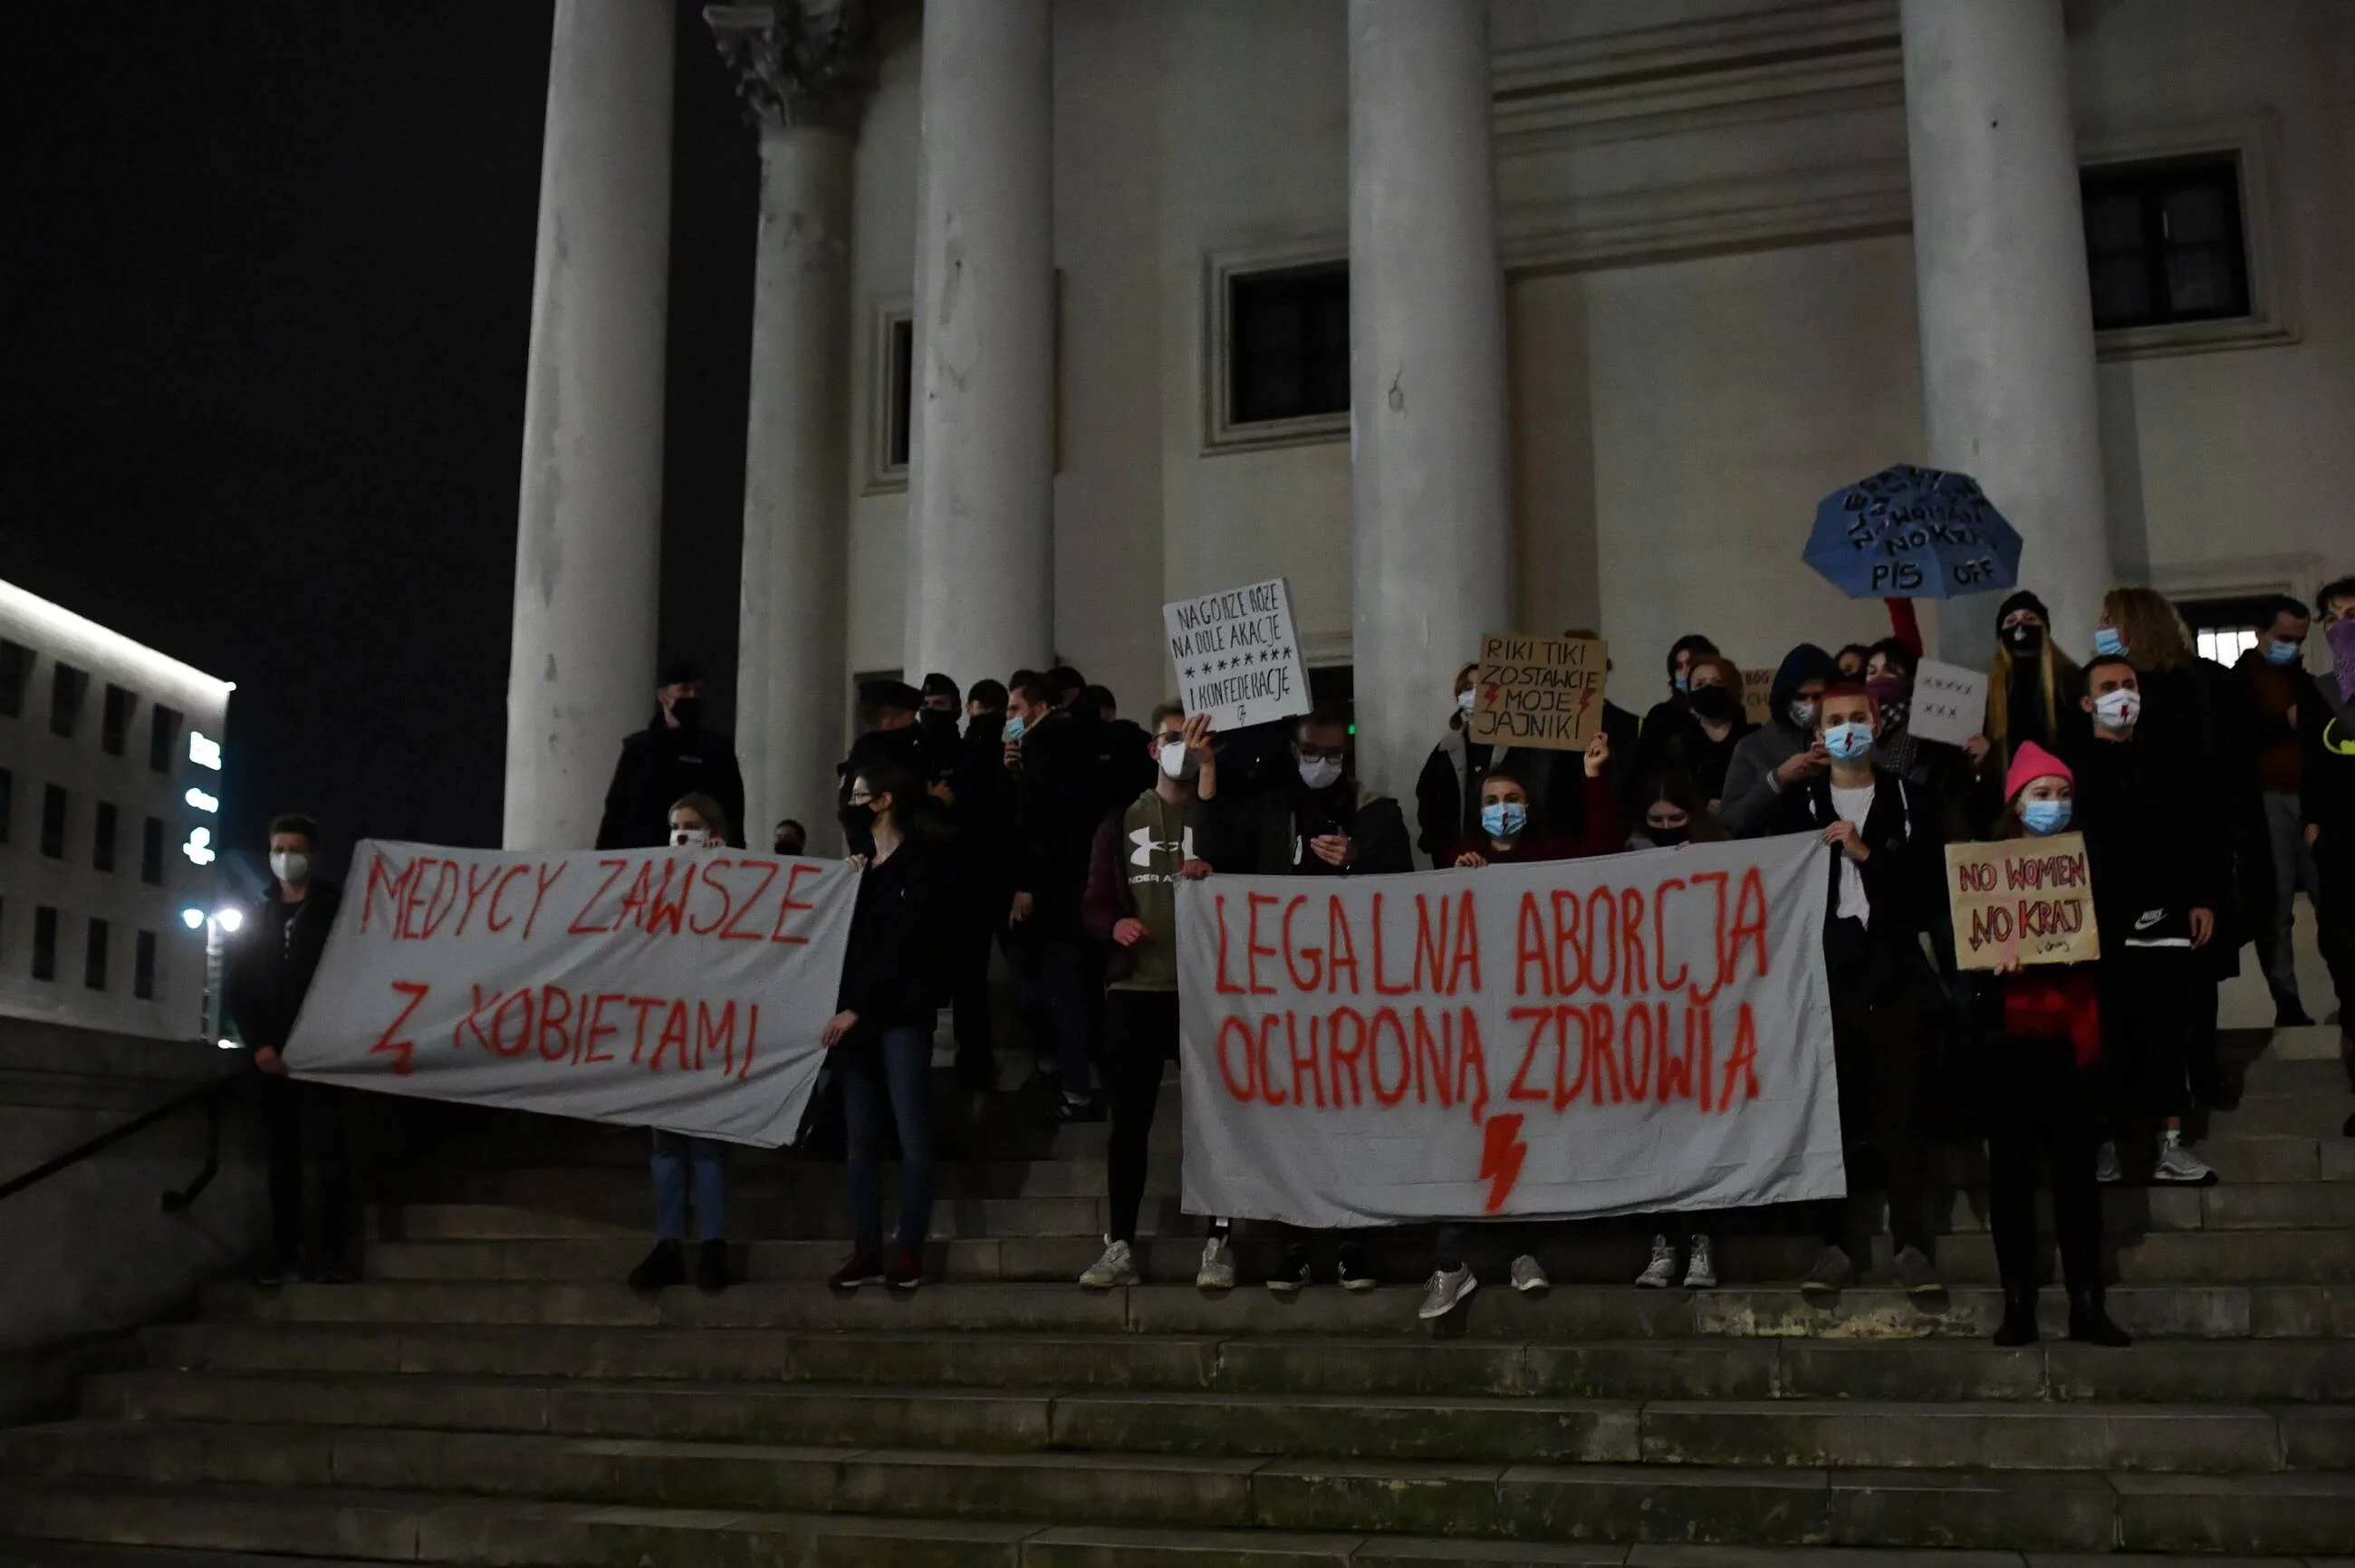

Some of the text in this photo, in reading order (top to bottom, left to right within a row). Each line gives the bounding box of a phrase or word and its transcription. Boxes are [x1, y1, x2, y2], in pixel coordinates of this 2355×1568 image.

[1872, 561, 1924, 591] PIS
[1177, 604, 1201, 631] NA
[1172, 613, 1283, 659] NA DOLE AKACJE
[1486, 638, 1587, 666] RIKI TIKI
[1480, 664, 1600, 690] ZOSTAWCIE
[1189, 688, 1196, 711] I
[1505, 688, 1572, 712] MOJE
[1478, 710, 1581, 740] JAJNIKI
[1128, 873, 1160, 884] NDER
[1959, 851, 2087, 891] NO WOMEN
[360, 853, 823, 945] MEDYCY ZAWSZE
[1215, 865, 1770, 1002] LEGALNA ABORCJA
[1968, 899, 2083, 952] NO KRAJ
[370, 980, 760, 1082] Z KOBIETAMI
[1507, 999, 1761, 1115] ZDROWIA
